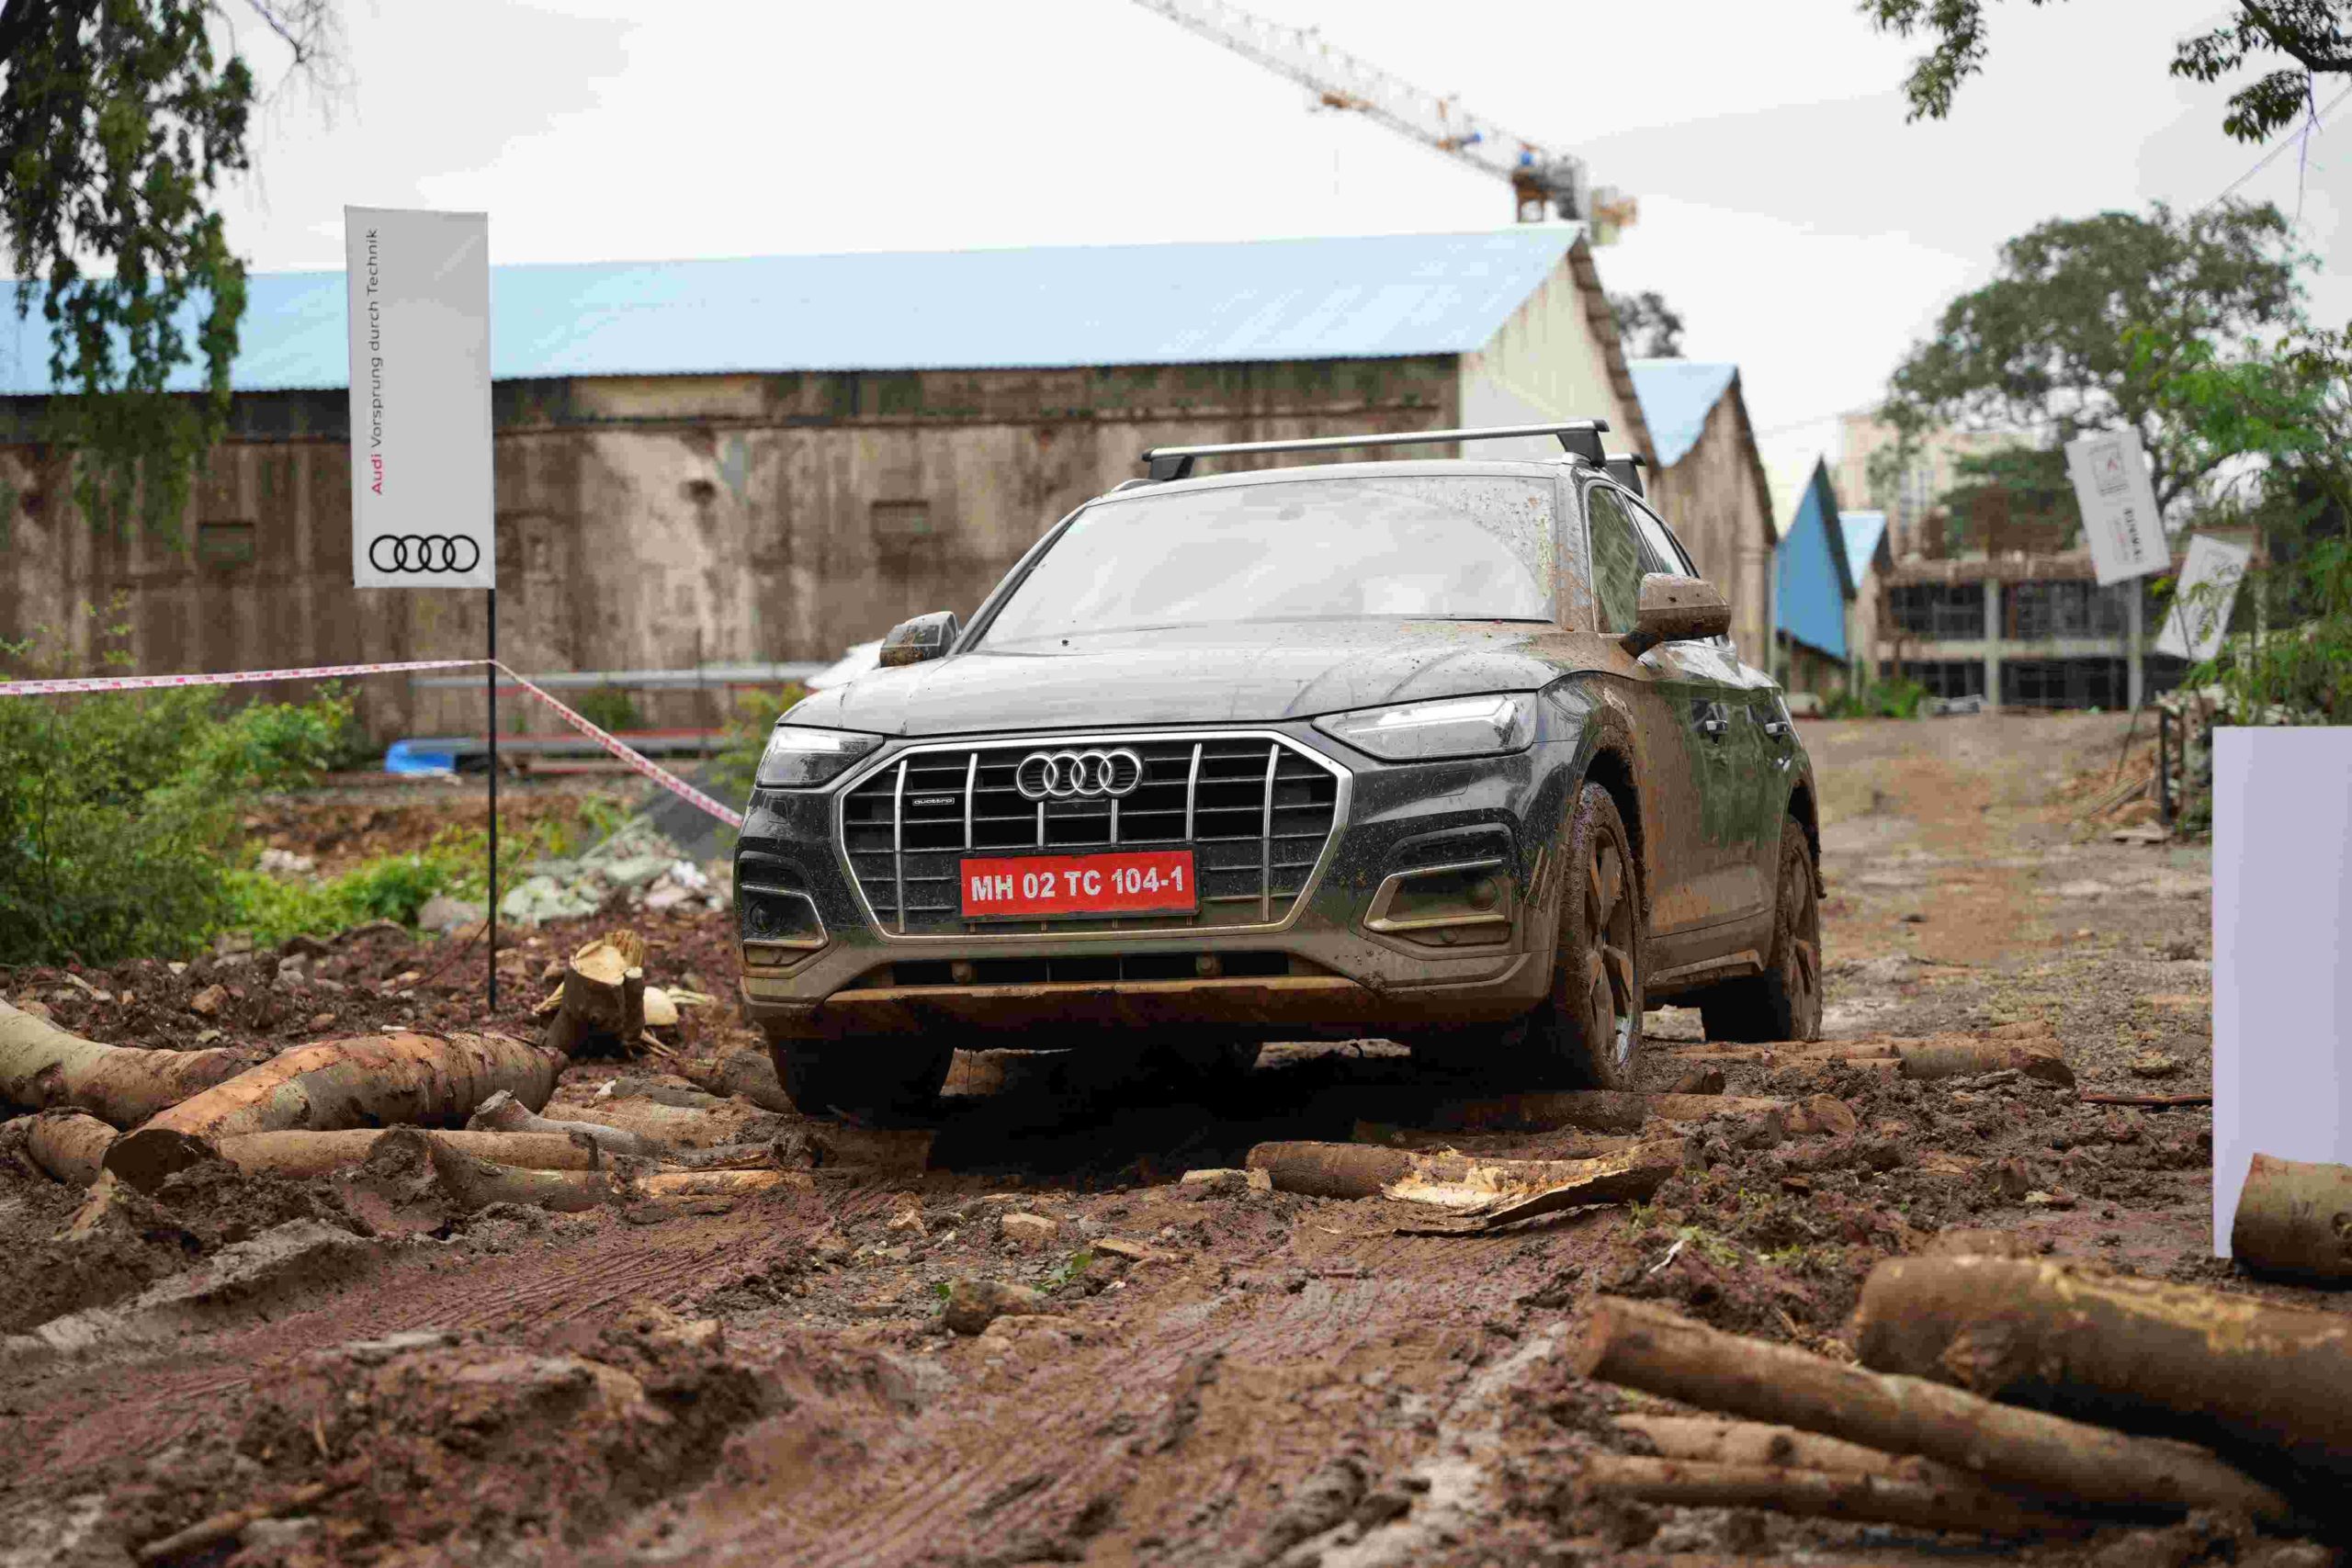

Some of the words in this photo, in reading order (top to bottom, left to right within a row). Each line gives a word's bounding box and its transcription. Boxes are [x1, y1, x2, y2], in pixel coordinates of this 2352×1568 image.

[366, 228, 379, 297] Technik
[368, 300, 380, 351] durch
[370, 356, 384, 448] Vorsprung
[370, 453, 382, 495] Audi
[971, 874, 1013, 901] MH
[1023, 872, 1056, 899] 02
[1064, 870, 1102, 897] TC
[1112, 865, 1183, 895] 104-1
